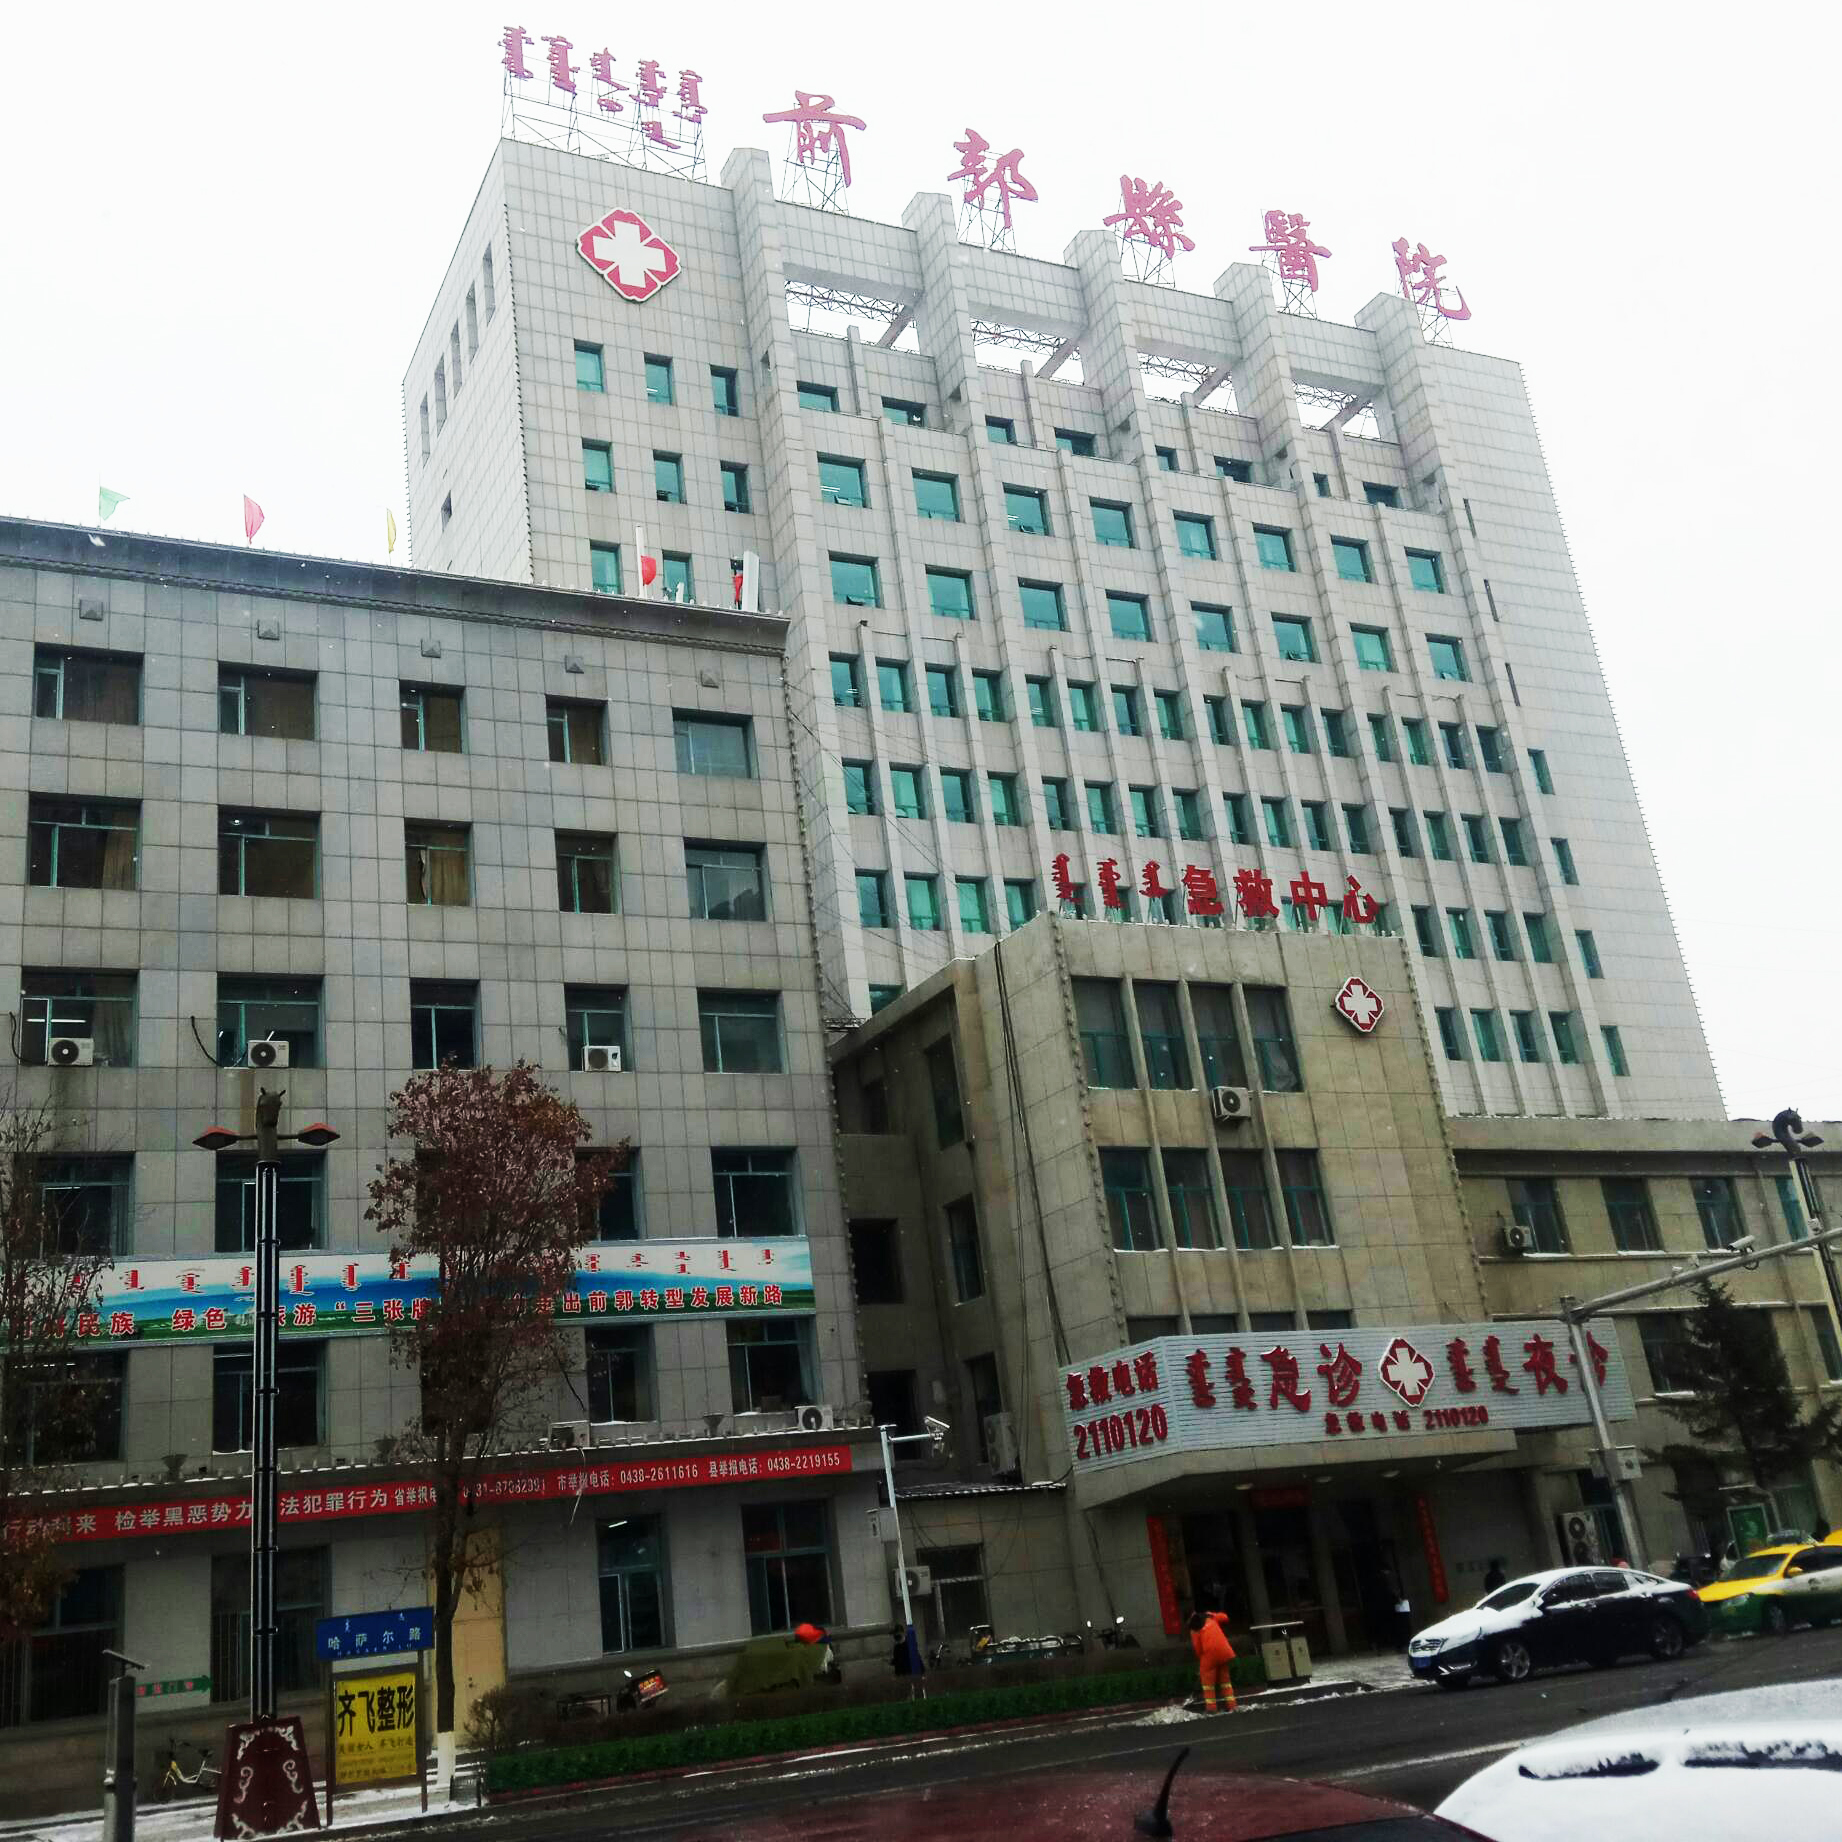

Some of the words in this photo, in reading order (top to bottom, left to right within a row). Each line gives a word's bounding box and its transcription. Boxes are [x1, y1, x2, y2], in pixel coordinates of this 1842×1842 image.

[1182, 863, 1379, 923] 急救中心
[172, 1307, 227, 1333] 绿色
[1066, 1350, 1159, 1410] 急救电话
[1260, 1342, 1362, 1412] 急诊
[1074, 1403, 1168, 1459] 2110120
[327, 1626, 422, 1651] 哈萨尔路
[338, 1685, 414, 1738] 齐飞整形
